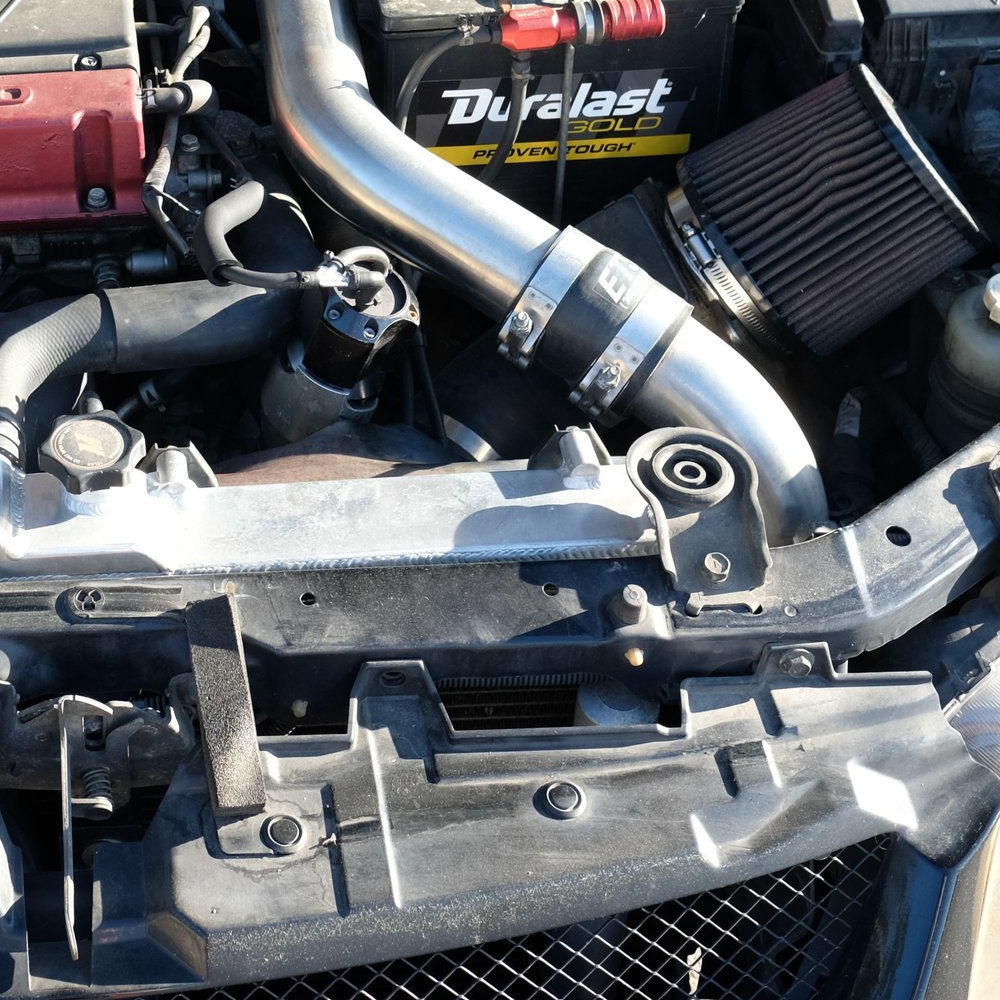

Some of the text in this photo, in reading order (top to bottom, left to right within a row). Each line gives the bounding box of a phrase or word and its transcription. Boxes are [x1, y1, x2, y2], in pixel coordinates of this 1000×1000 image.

[442, 78, 672, 125] Duralast
[567, 116, 662, 134] GOLD
[473, 142, 632, 160] PRVEN TOUGH
